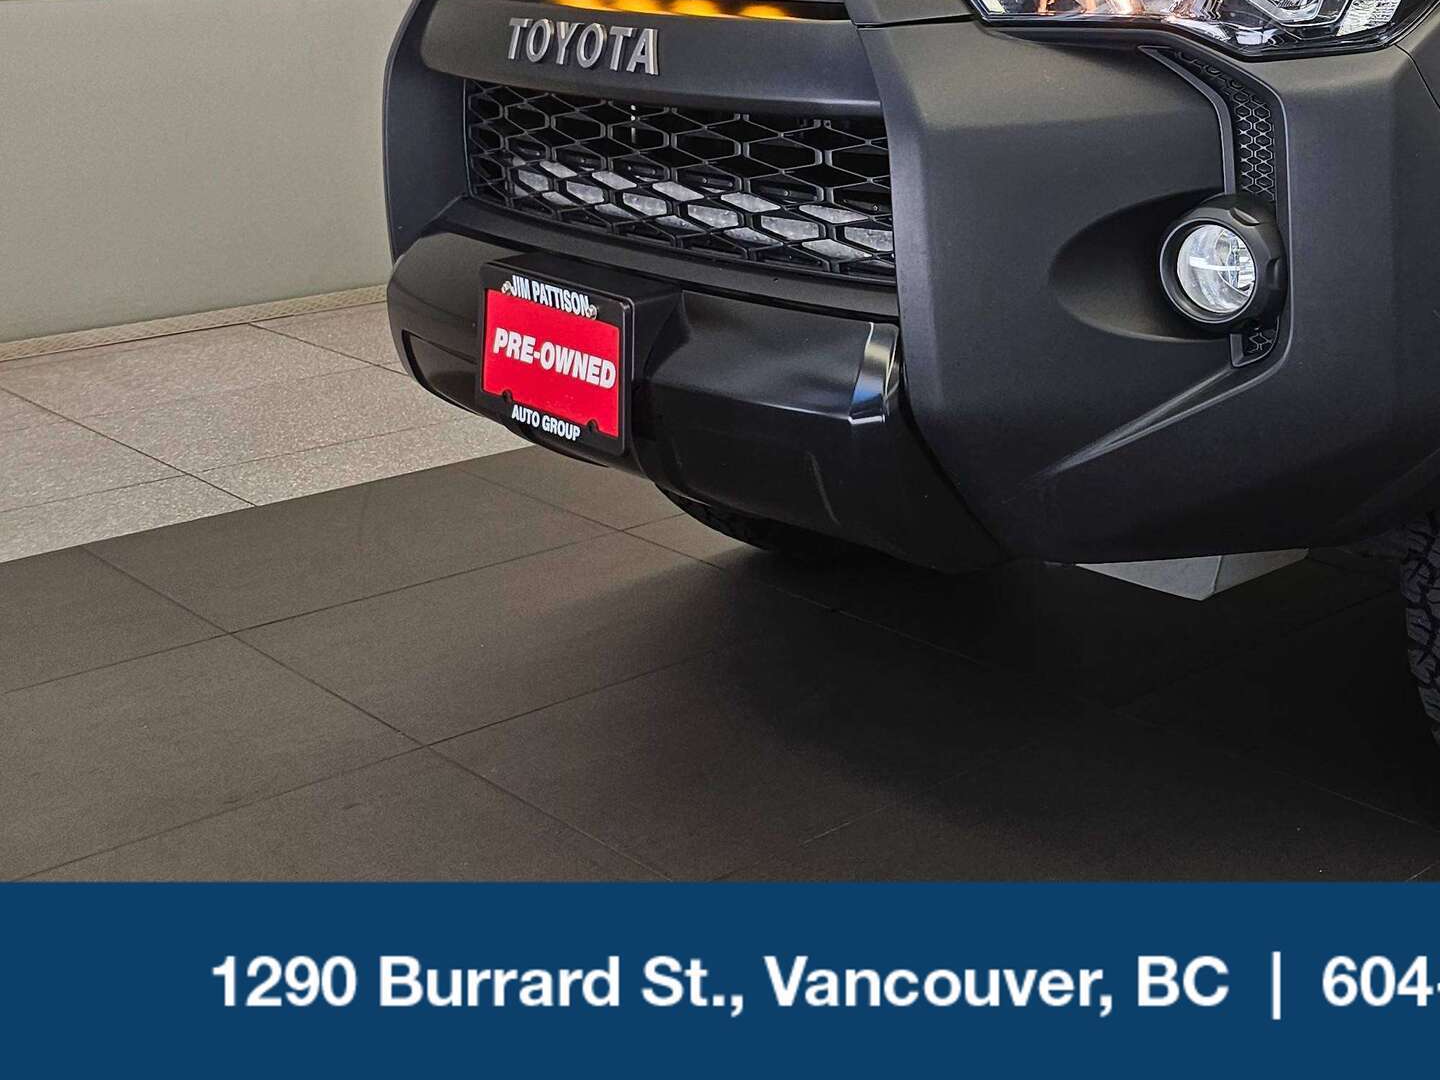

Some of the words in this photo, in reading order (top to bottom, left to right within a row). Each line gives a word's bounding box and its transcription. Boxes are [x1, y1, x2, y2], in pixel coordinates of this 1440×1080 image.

[508, 17, 659, 76] TOYOTA
[511, 275, 531, 299] JIM
[531, 279, 590, 318] PATTISON
[492, 327, 617, 389] PRE-OWNED
[511, 404, 540, 428] AUTO
[541, 415, 581, 441] GROUP
